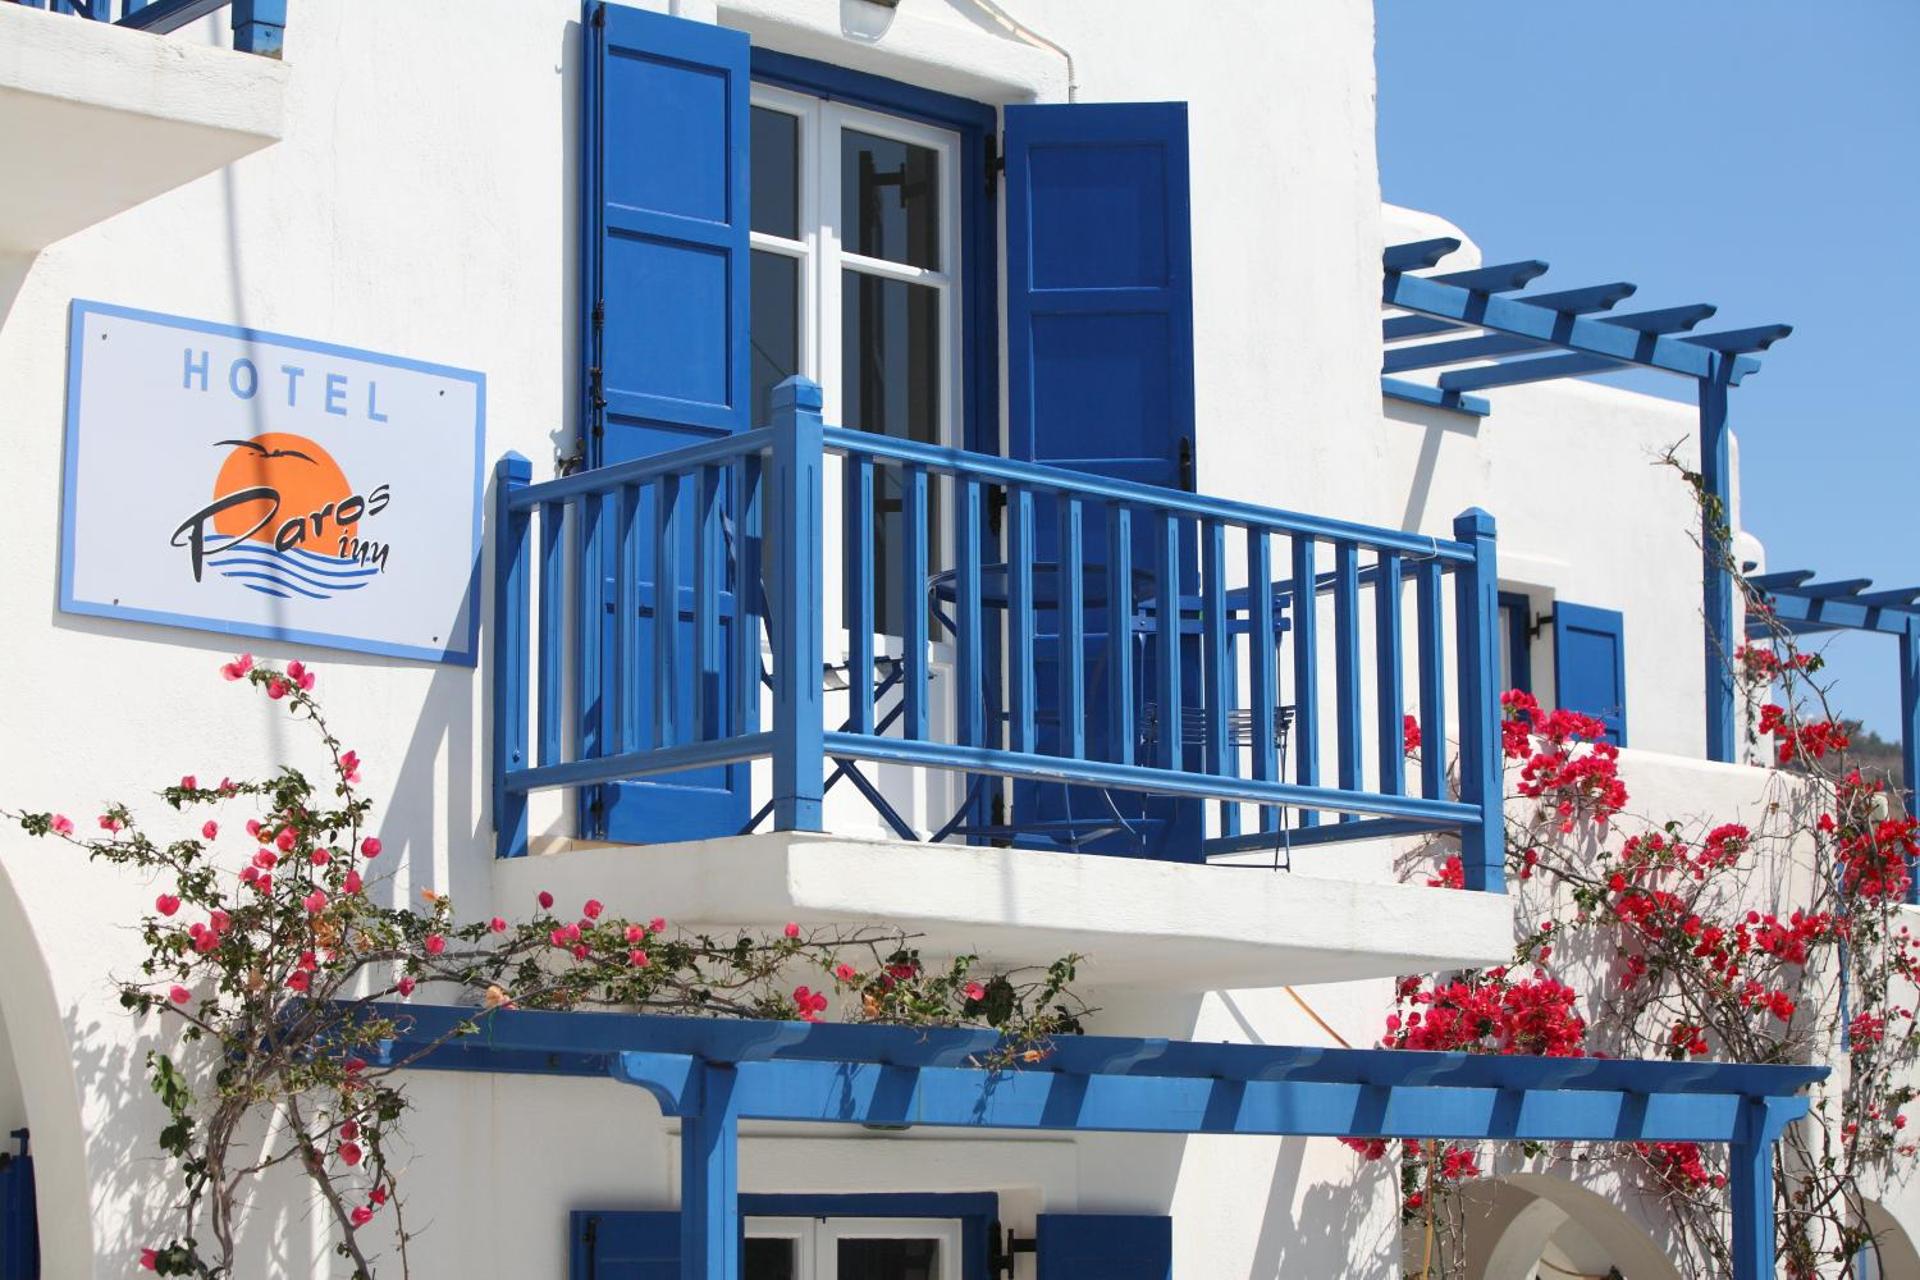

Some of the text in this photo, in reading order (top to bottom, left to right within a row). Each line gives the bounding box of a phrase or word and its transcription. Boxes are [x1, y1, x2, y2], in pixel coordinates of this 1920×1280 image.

[183, 348, 388, 423] HOTEL
[171, 484, 390, 582] Paros
[339, 530, 390, 573] inn
